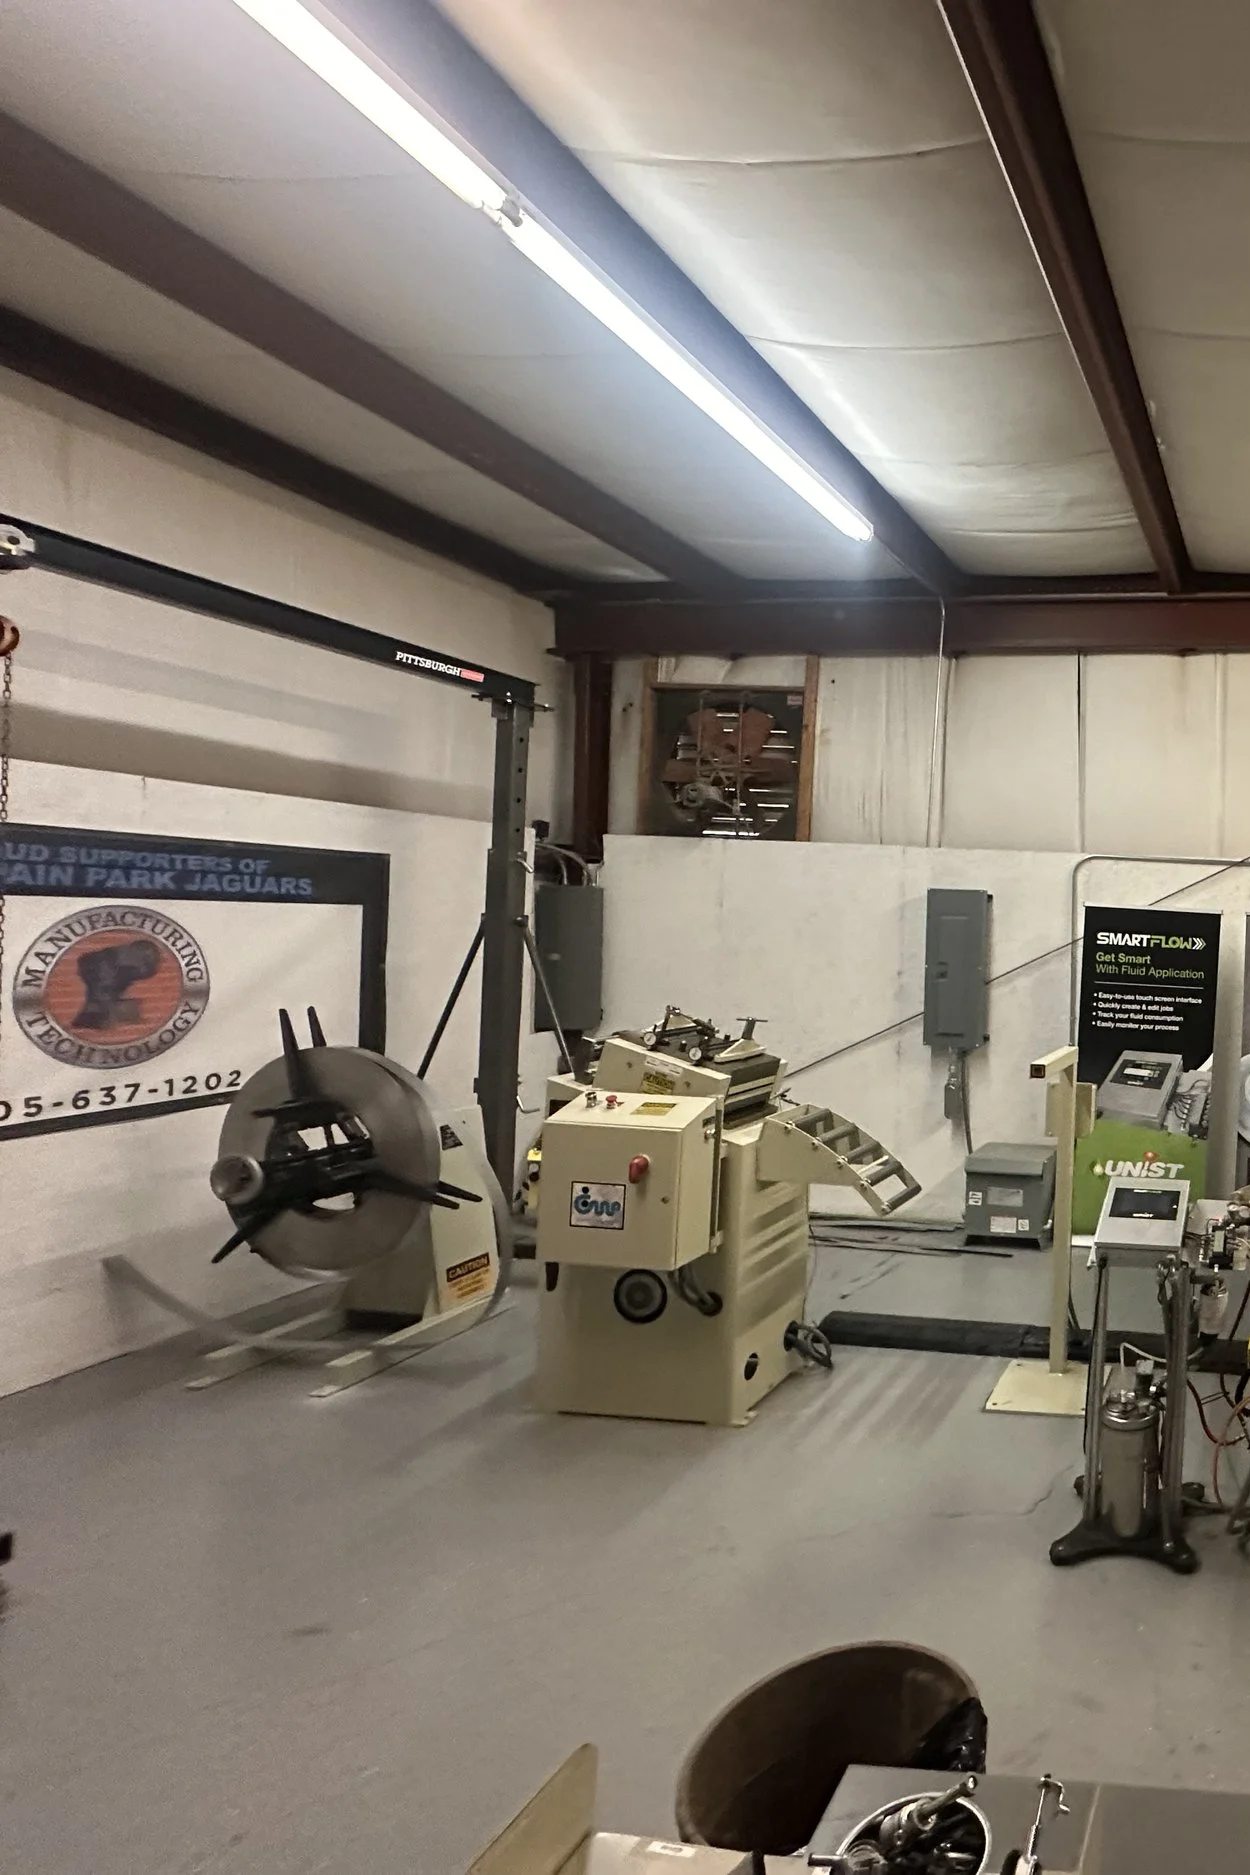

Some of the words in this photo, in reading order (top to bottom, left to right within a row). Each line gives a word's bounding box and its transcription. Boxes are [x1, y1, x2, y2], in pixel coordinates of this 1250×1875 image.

[395, 651, 462, 677] PITTSBURGH
[0, 841, 49, 863] UD
[59, 845, 232, 872] SUPPORTERS
[238, 858, 271, 874] OF
[85, 867, 178, 890] PARK
[183, 872, 313, 896] JAGUARS
[22, 911, 203, 988] MANUFACTURING
[1096, 931, 1192, 949] SMARTFLOW
[1096, 952, 1116, 962] Get
[1118, 952, 1151, 964] Smart
[1096, 964, 1119, 974] With
[1121, 965, 1146, 975] Fluid
[1148, 966, 1205, 979] Application
[1098, 992, 1135, 1000] Easy-to-use
[1176, 996, 1202, 1004] interface
[1098, 1001, 1120, 1010] Quickly
[1097, 1020, 1115, 1029] Easily
[1116, 1021, 1139, 1029] monitor
[1144, 1014, 1184, 1022] consumption
[26, 1000, 200, 1064] TECHNOLOGY
[1105, 1159, 1185, 1179] UNIST
[448, 1256, 488, 1279] CAUTION
